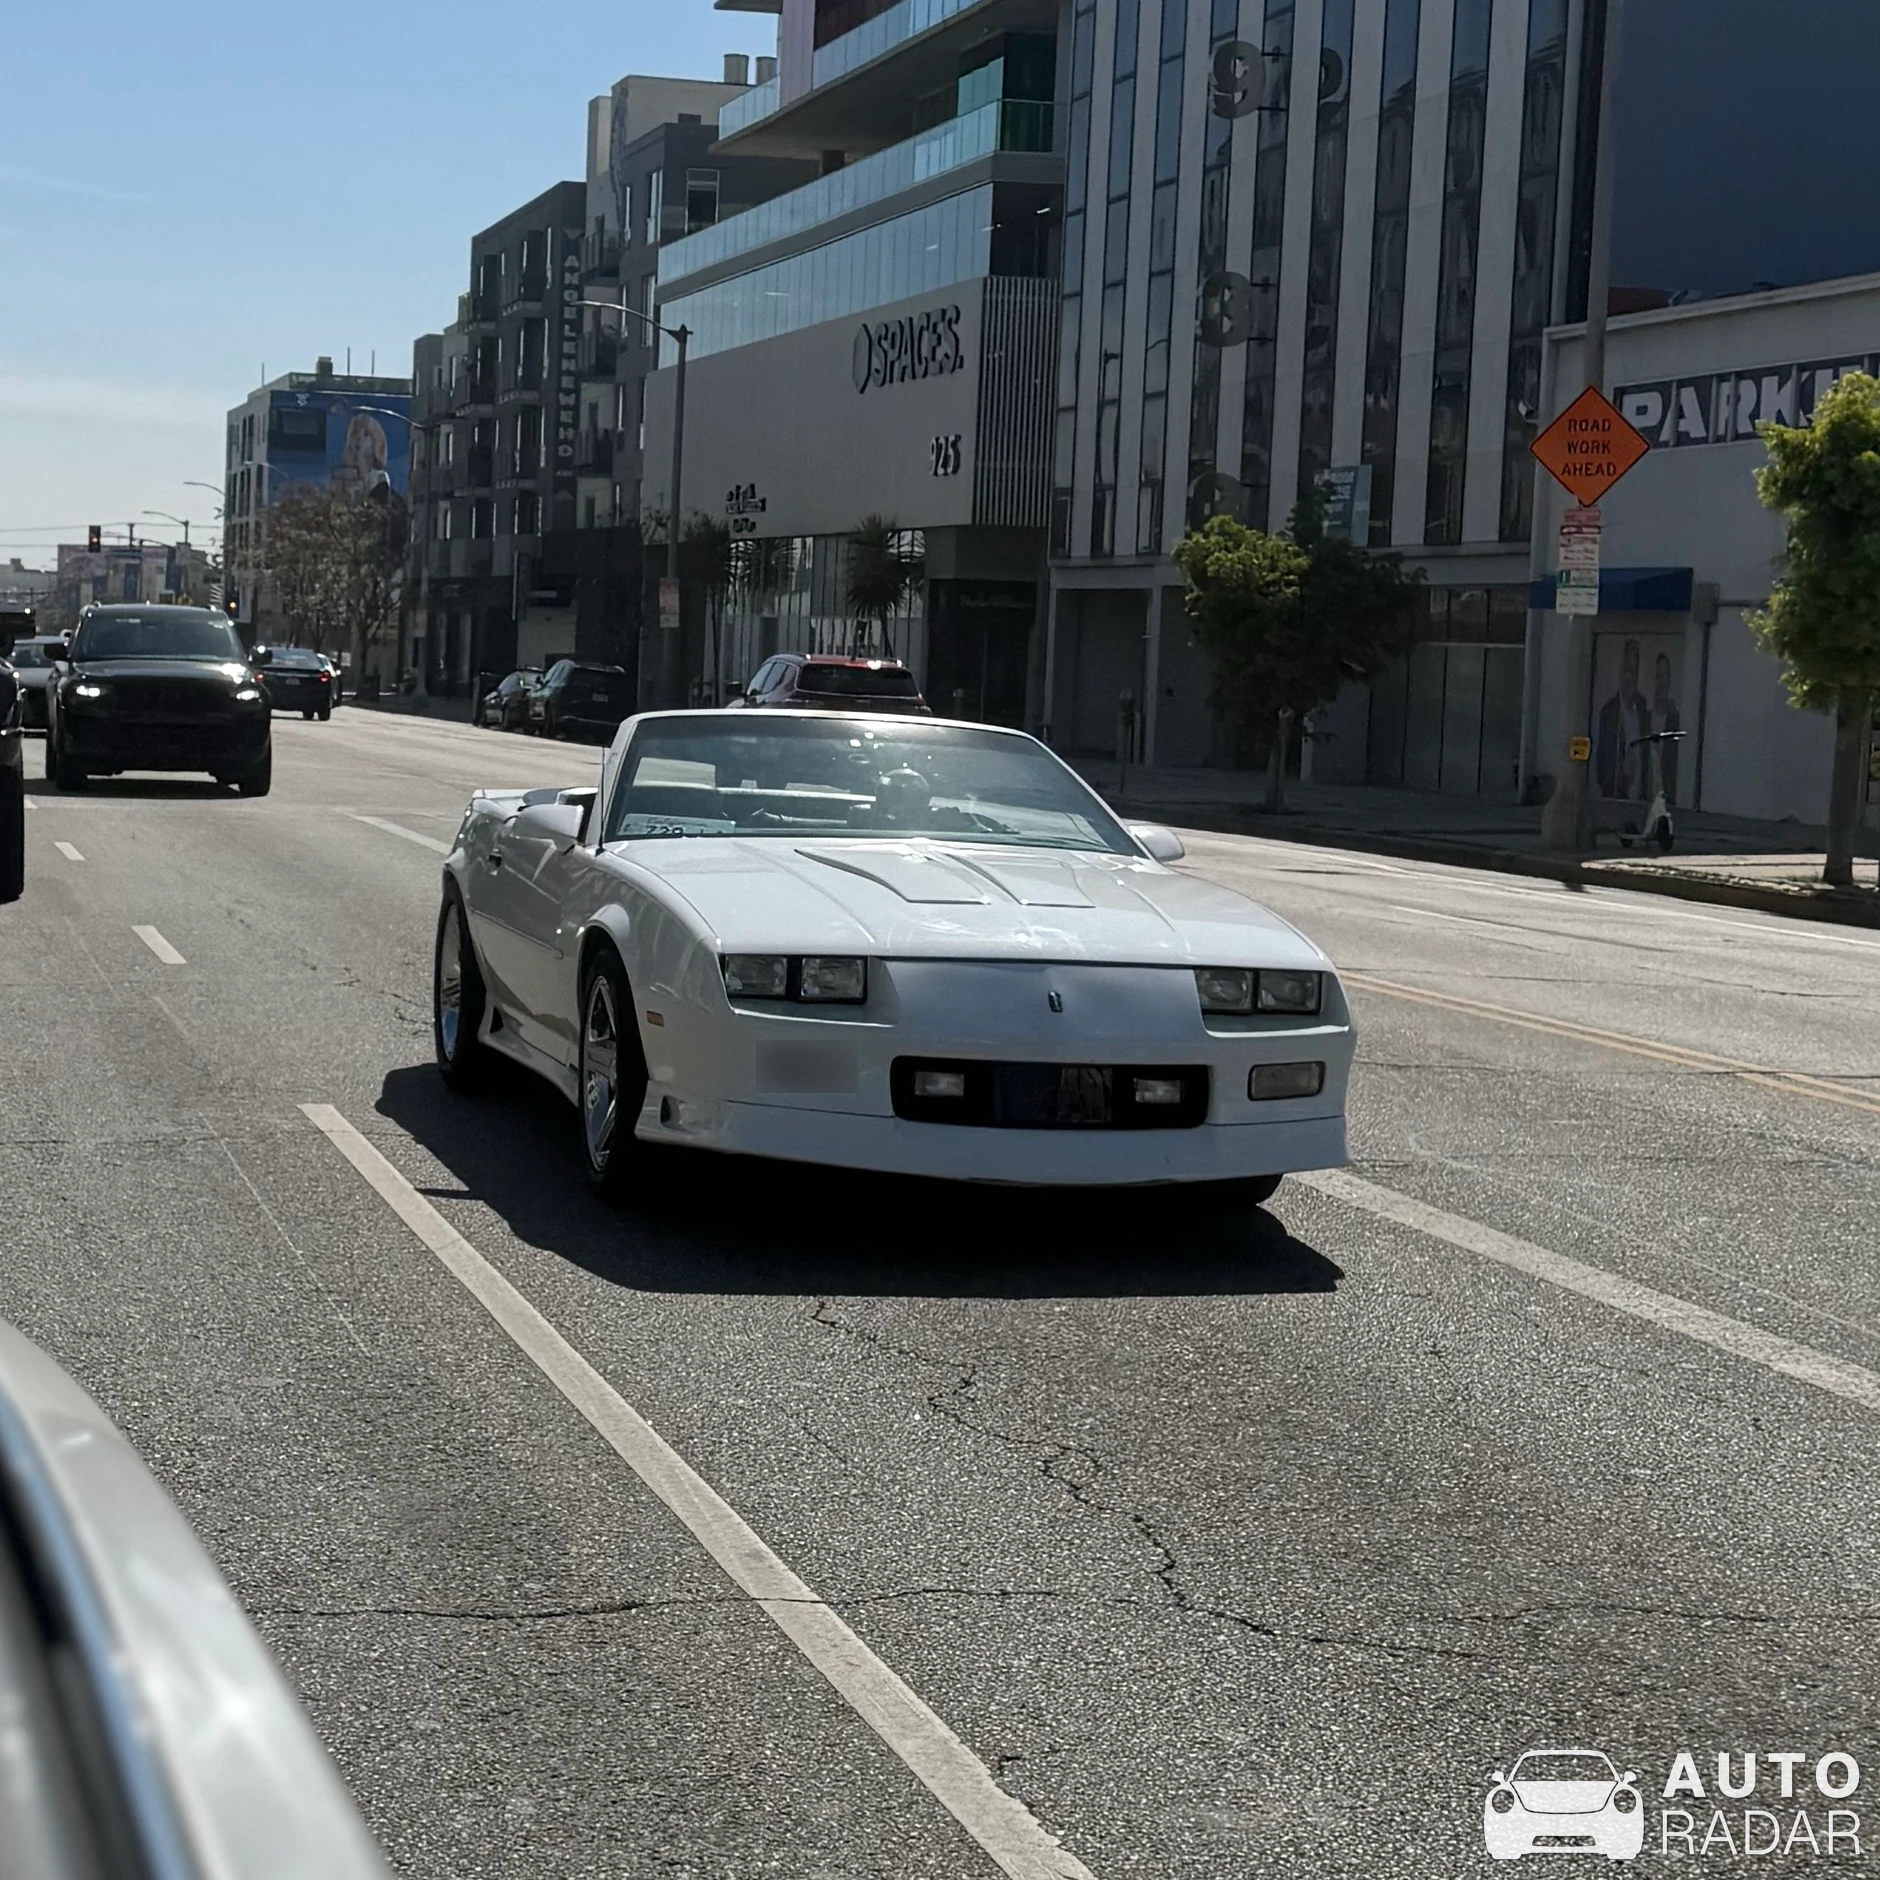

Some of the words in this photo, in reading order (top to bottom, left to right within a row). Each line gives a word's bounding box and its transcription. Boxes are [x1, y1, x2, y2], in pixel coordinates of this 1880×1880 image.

[1568, 418, 1611, 432] ROAD
[1567, 440, 1611, 454] WORK
[929, 434, 962, 477] 925
[1561, 462, 1617, 477] AHEAD
